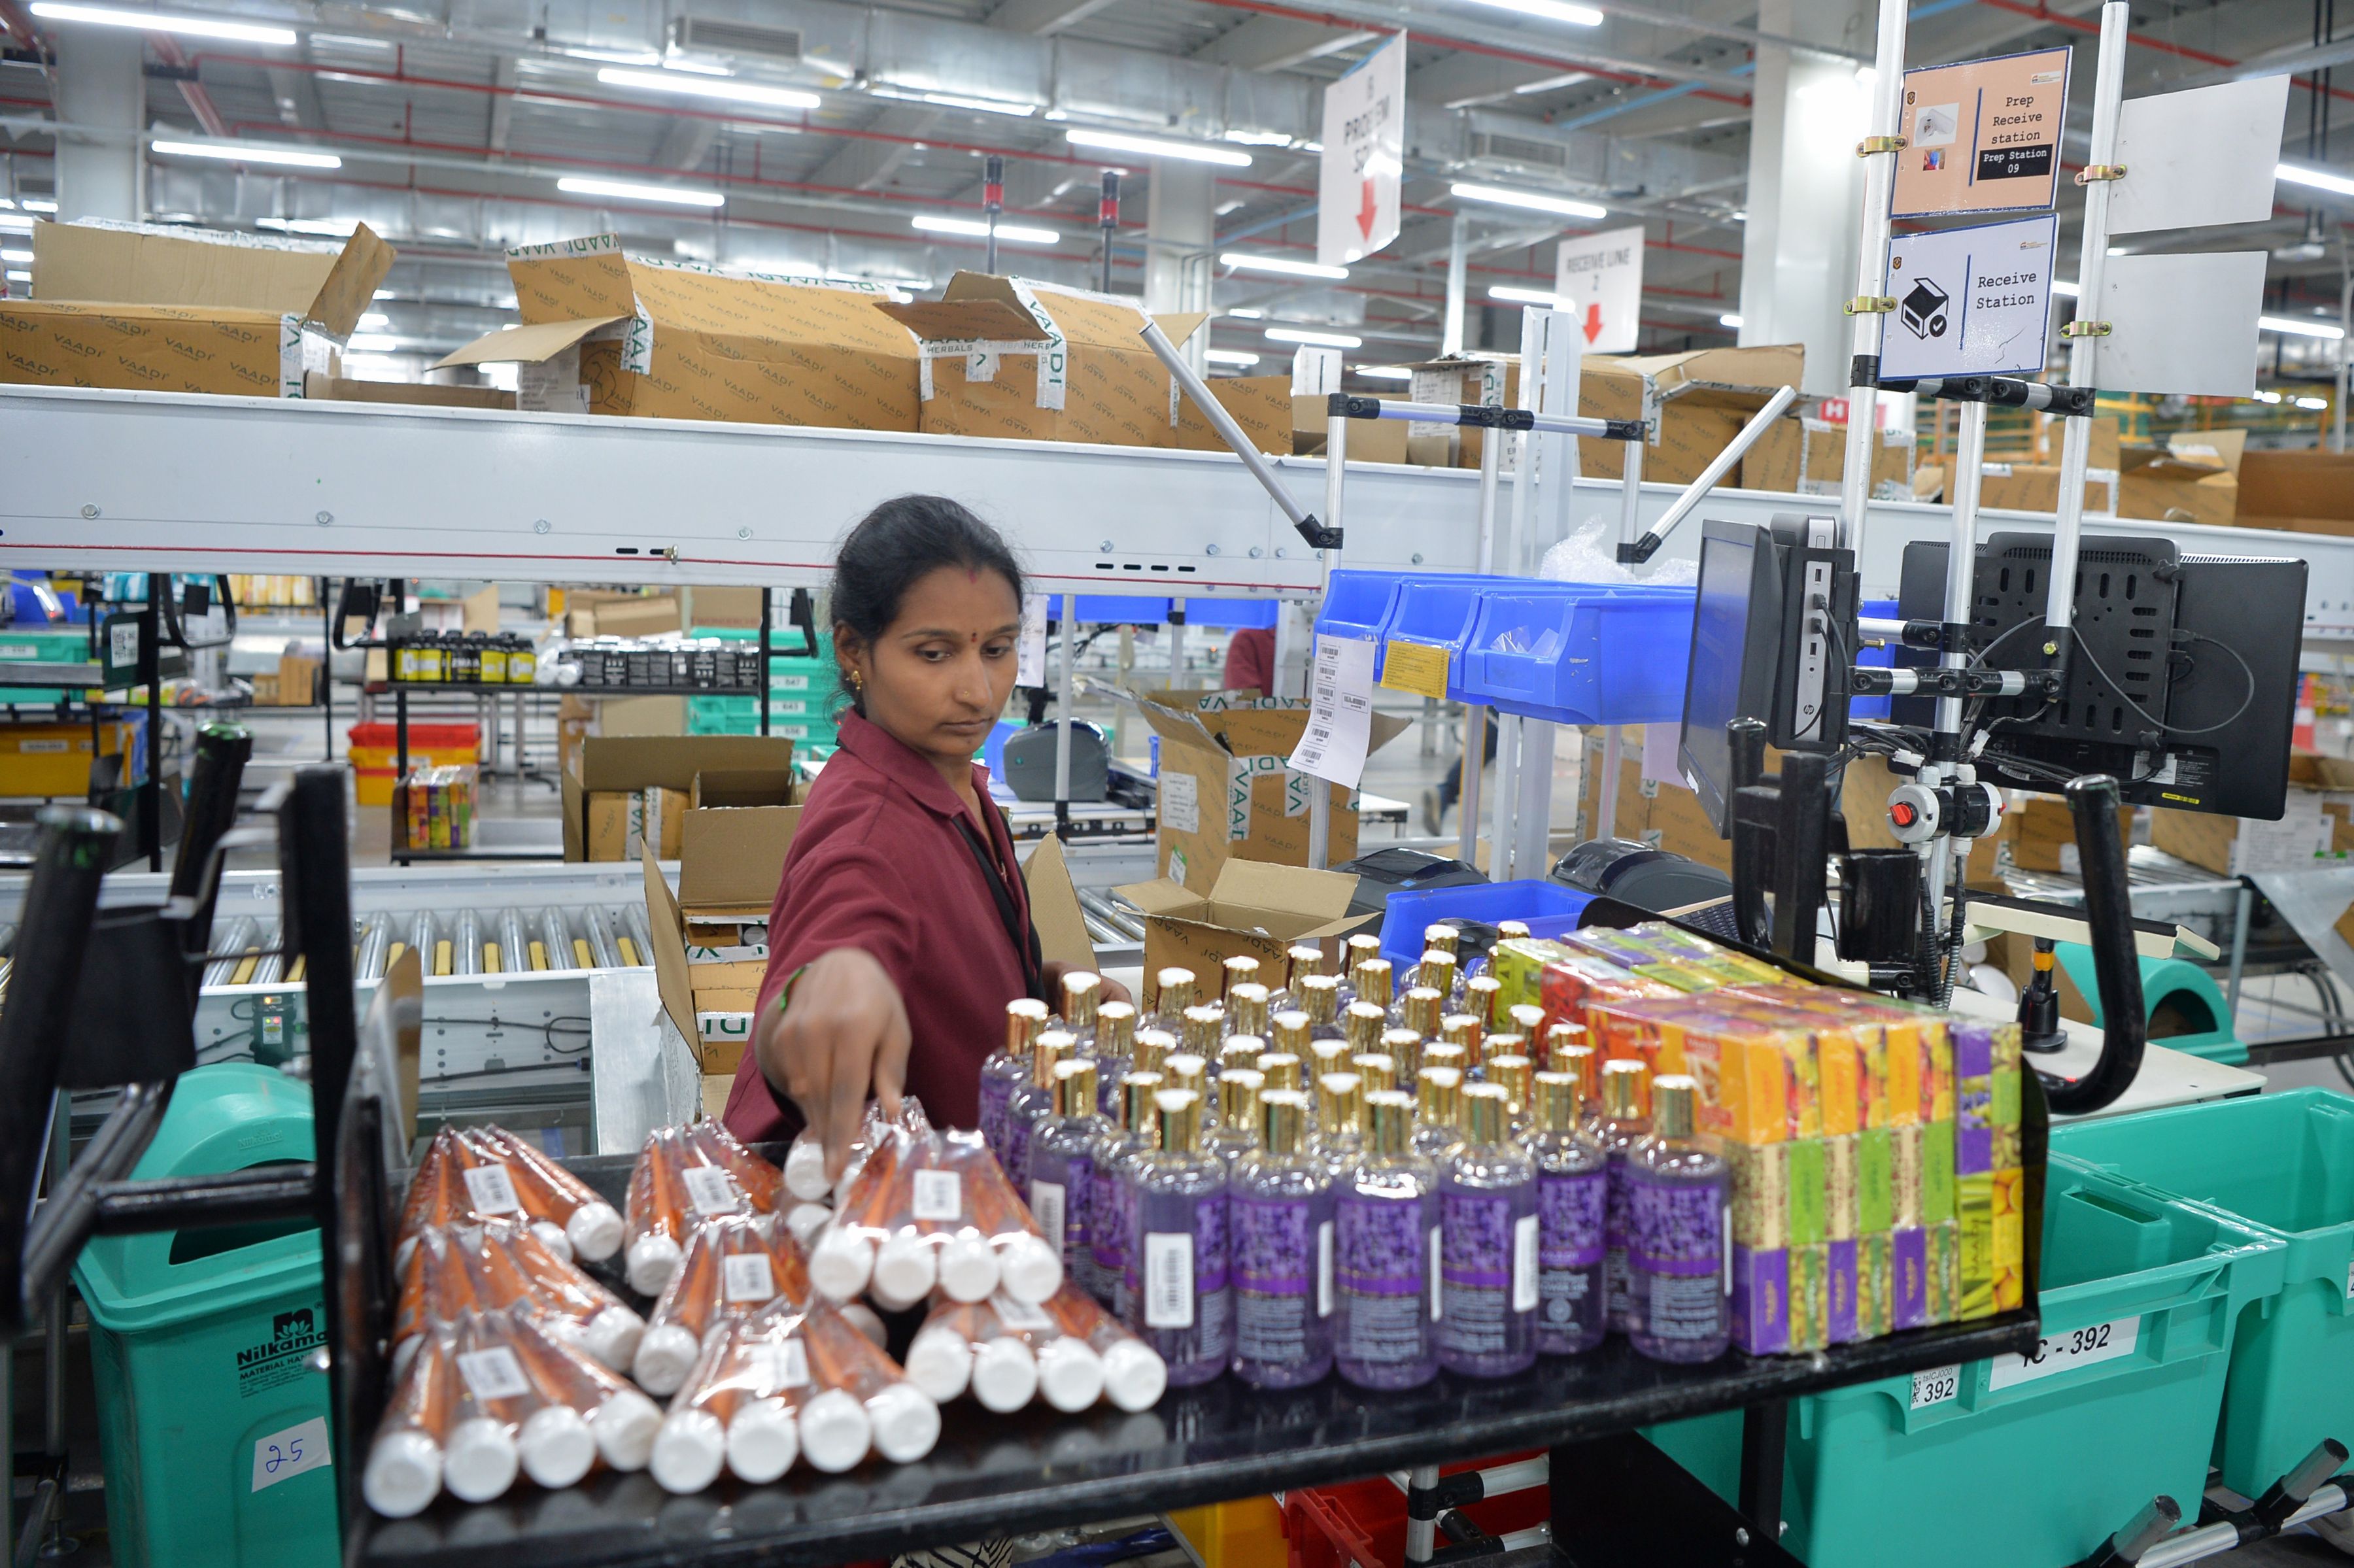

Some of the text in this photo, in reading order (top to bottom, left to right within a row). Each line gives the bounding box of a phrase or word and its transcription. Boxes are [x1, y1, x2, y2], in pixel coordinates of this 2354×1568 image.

[2005, 95, 2034, 107] Prep
[1992, 112, 2043, 127] Receive
[1991, 131, 2041, 145] station
[1983, 148, 2047, 163] Prep Station
[2007, 163, 2020, 174] 09
[1977, 271, 2038, 288] Receive
[1976, 294, 2035, 309] Station
[211, 320, 258, 343] VAADI
[54, 333, 103, 358] VAADI
[165, 337, 213, 360] VAADI
[711, 337, 746, 360] VAADI
[927, 345, 974, 354] HERBALS
[6, 351, 56, 376] VAADI
[119, 356, 166, 380] VAADI
[677, 353, 713, 379] VAADI
[791, 349, 825, 372] VAADI
[230, 362, 277, 385] VAADI
[757, 363, 793, 387] VAADI
[1082, 363, 1108, 384] VAADI
[724, 378, 760, 403] VAADI
[835, 374, 868, 397] VAADI
[1114, 384, 1137, 405] VAADI
[1227, 378, 1257, 396] VAADI
[691, 395, 727, 420] VAADI
[804, 388, 837, 412] VAADI
[877, 398, 908, 419] VAADI
[961, 398, 991, 418] VAADI
[1093, 401, 1116, 421] VAADI
[1238, 413, 1269, 430] VAADI
[930, 417, 961, 435] VAADI
[1001, 417, 1033, 436] VAADI
[1069, 418, 1093, 440] VAADI
[1804, 704, 1814, 715] hp
[1250, 725, 1286, 738] VAADI
[1253, 800, 1285, 817] VAADI
[1265, 835, 1297, 851] VAADI
[2070, 1323, 2111, 1355] 392
[239, 1361, 286, 1381] MATERIAL
[1924, 1377, 1954, 1403] 392
[265, 1438, 304, 1473] 25
